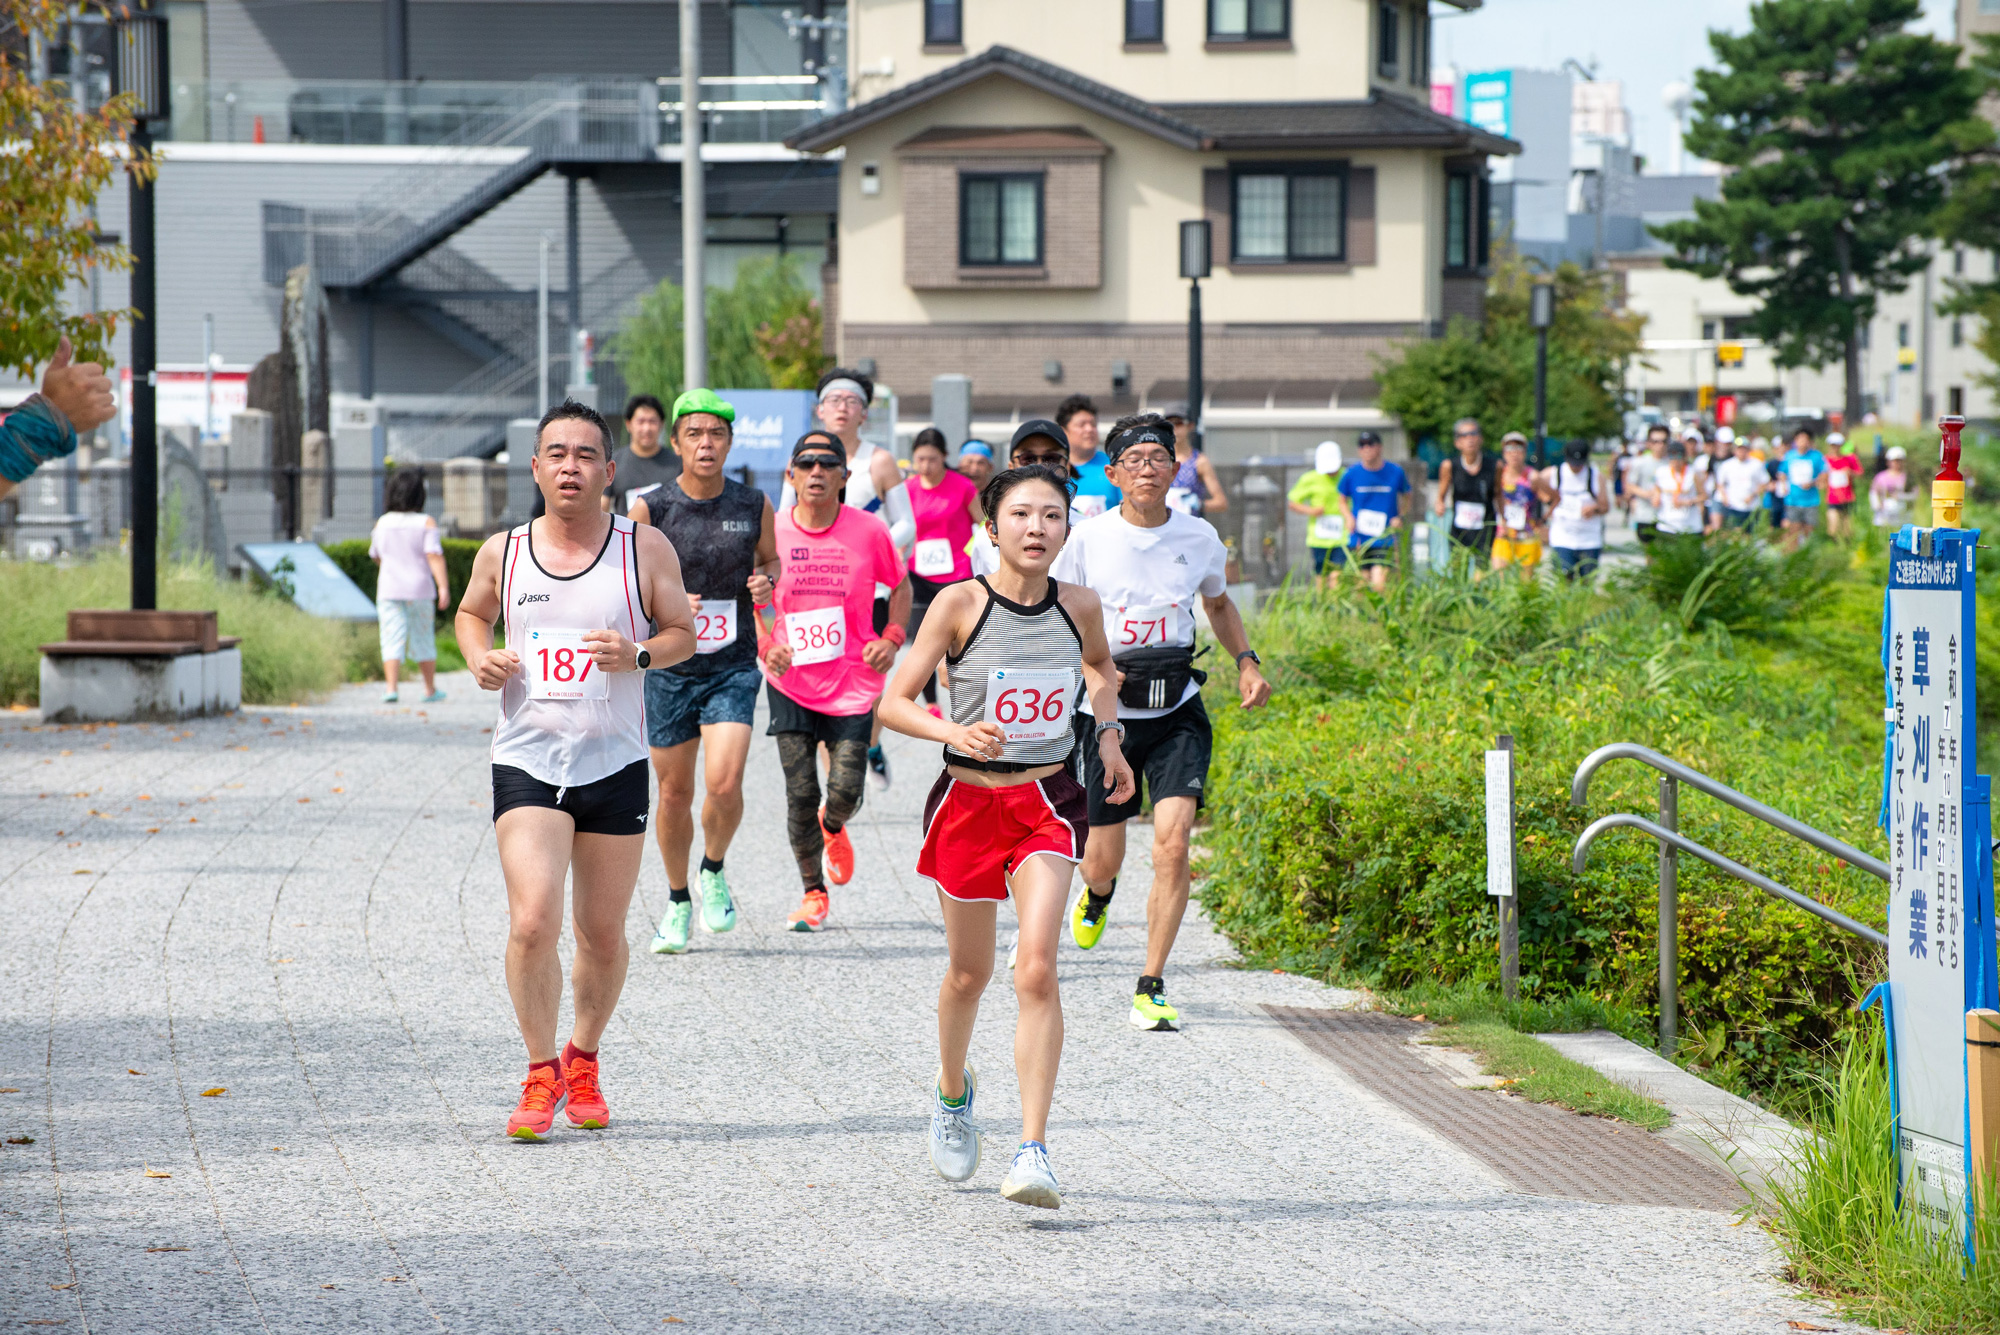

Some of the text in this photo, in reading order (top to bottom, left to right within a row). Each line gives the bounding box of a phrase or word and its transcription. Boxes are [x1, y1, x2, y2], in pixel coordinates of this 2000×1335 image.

[787, 564, 850, 575] KUROBE
[795, 577, 844, 587] MEISUI
[1896, 560, 1958, 585] ご迷惑をおかけします
[795, 621, 842, 651] 386
[1121, 616, 1167, 645] 571
[537, 648, 598, 682] 187
[995, 688, 1065, 724] 636
[1895, 631, 1905, 893] を予定しています
[1909, 626, 1931, 960] 草刈作業
